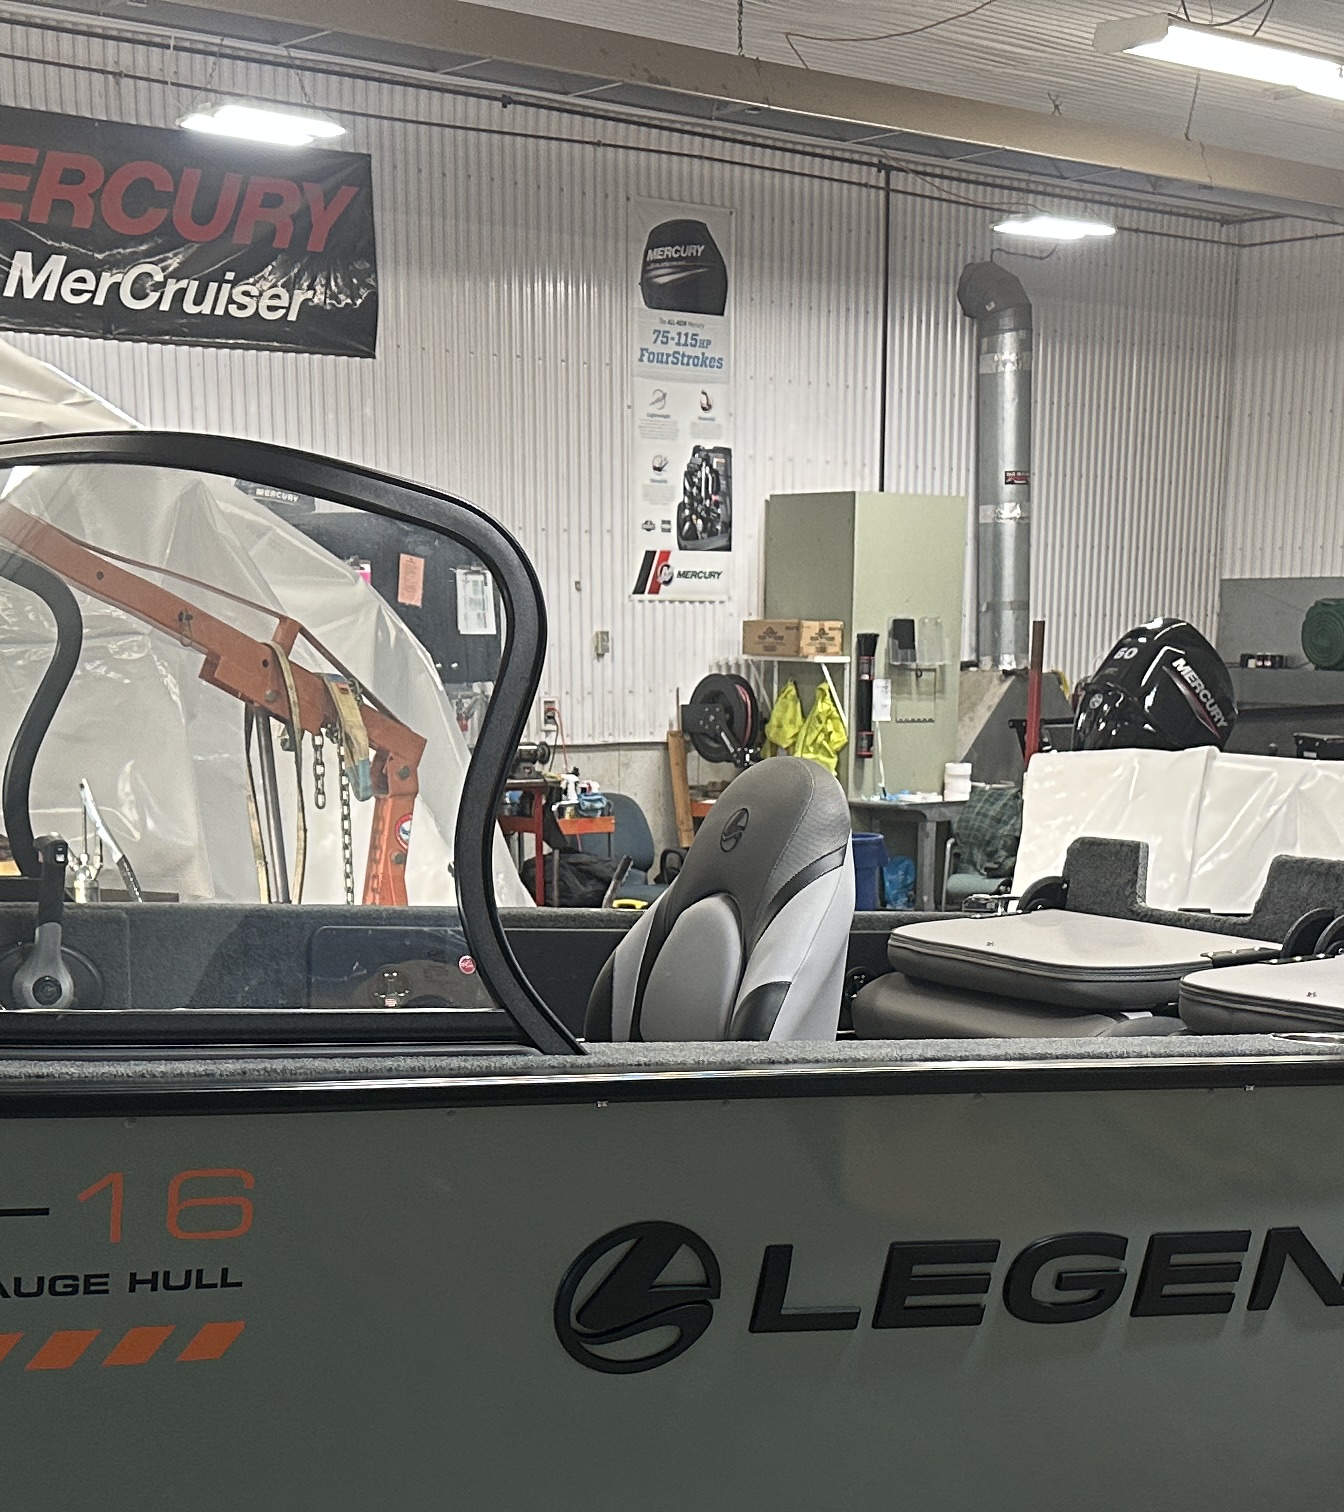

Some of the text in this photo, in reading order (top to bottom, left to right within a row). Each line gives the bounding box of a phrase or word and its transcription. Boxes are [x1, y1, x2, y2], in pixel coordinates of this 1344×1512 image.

[646, 244, 705, 261] MERCURY
[3, 251, 313, 321] MerCruiser
[638, 347, 724, 369] FourStrokes
[256, 488, 298, 502] MERCURY
[676, 570, 722, 580] MERCURY
[1172, 657, 1228, 728] MERCURY
[128, 1268, 243, 1294] HULL
